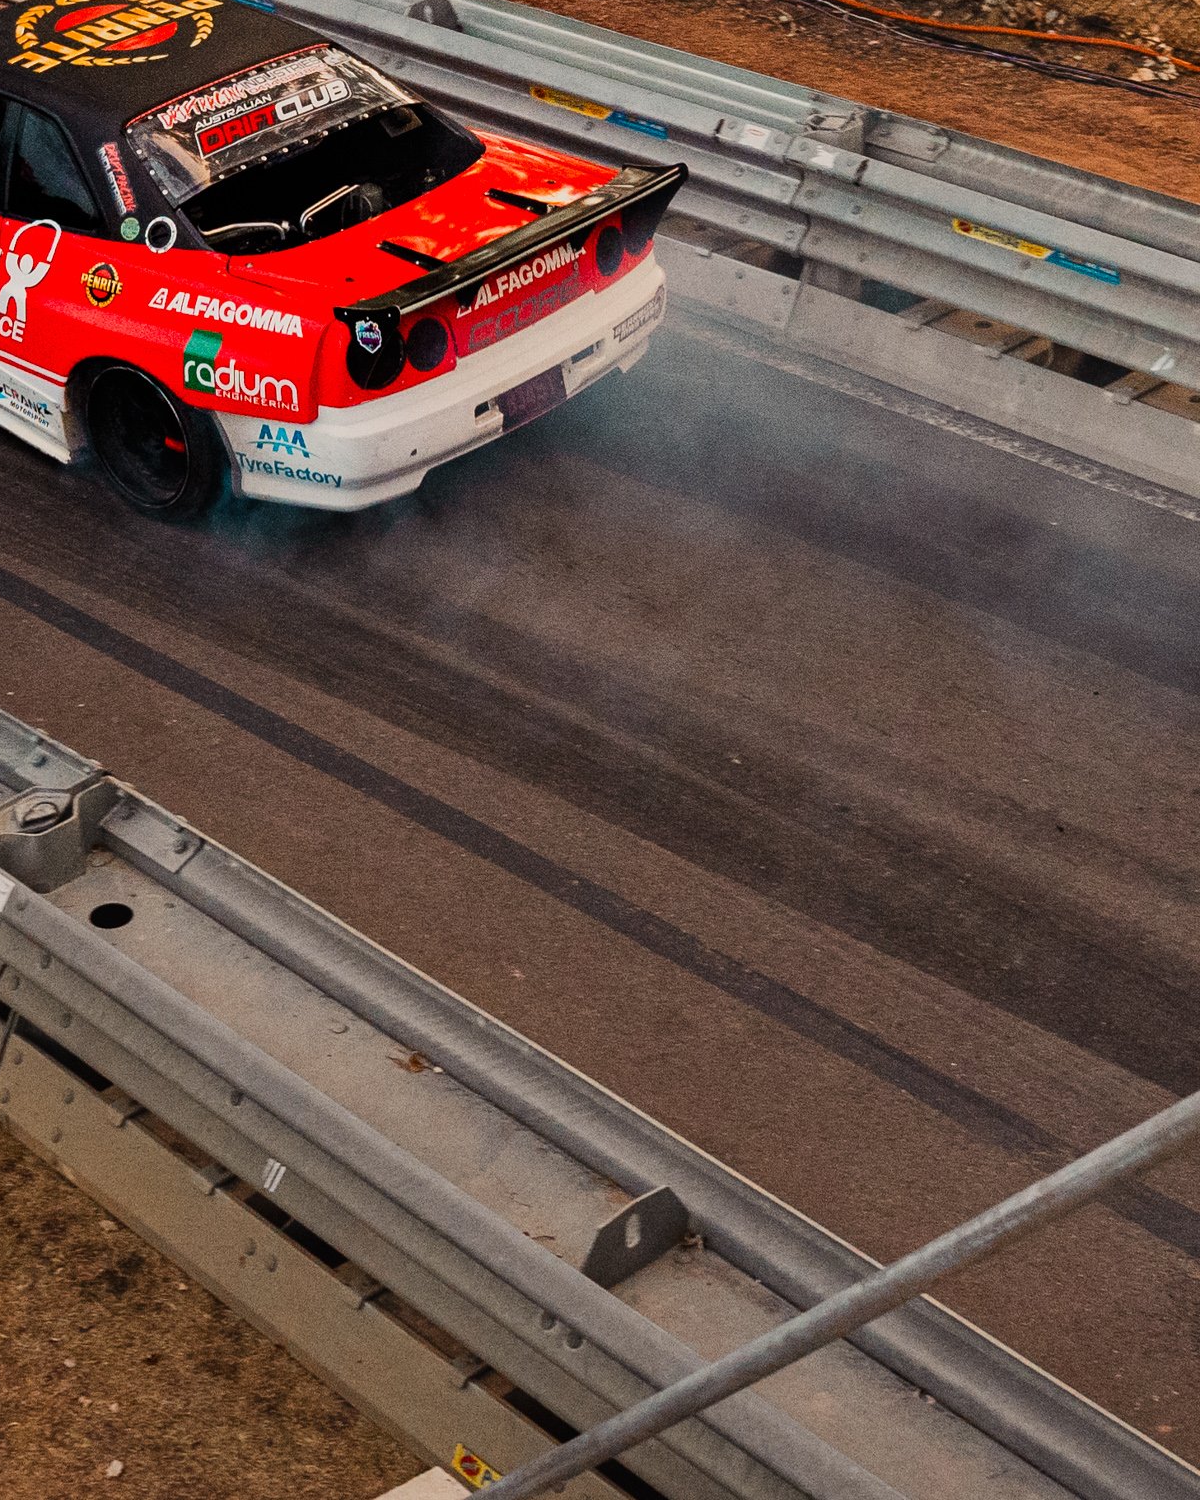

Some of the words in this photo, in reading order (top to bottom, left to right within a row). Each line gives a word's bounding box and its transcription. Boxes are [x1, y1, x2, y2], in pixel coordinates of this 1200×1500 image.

[195, 93, 272, 131] AUSTRALIAN
[81, 272, 123, 295] PENRITE
[166, 291, 303, 338] ALFAGOMMA
[184, 359, 298, 404] radium
[9, 400, 50, 428] MOTORSPORT
[215, 388, 299, 412] ENGINEERING
